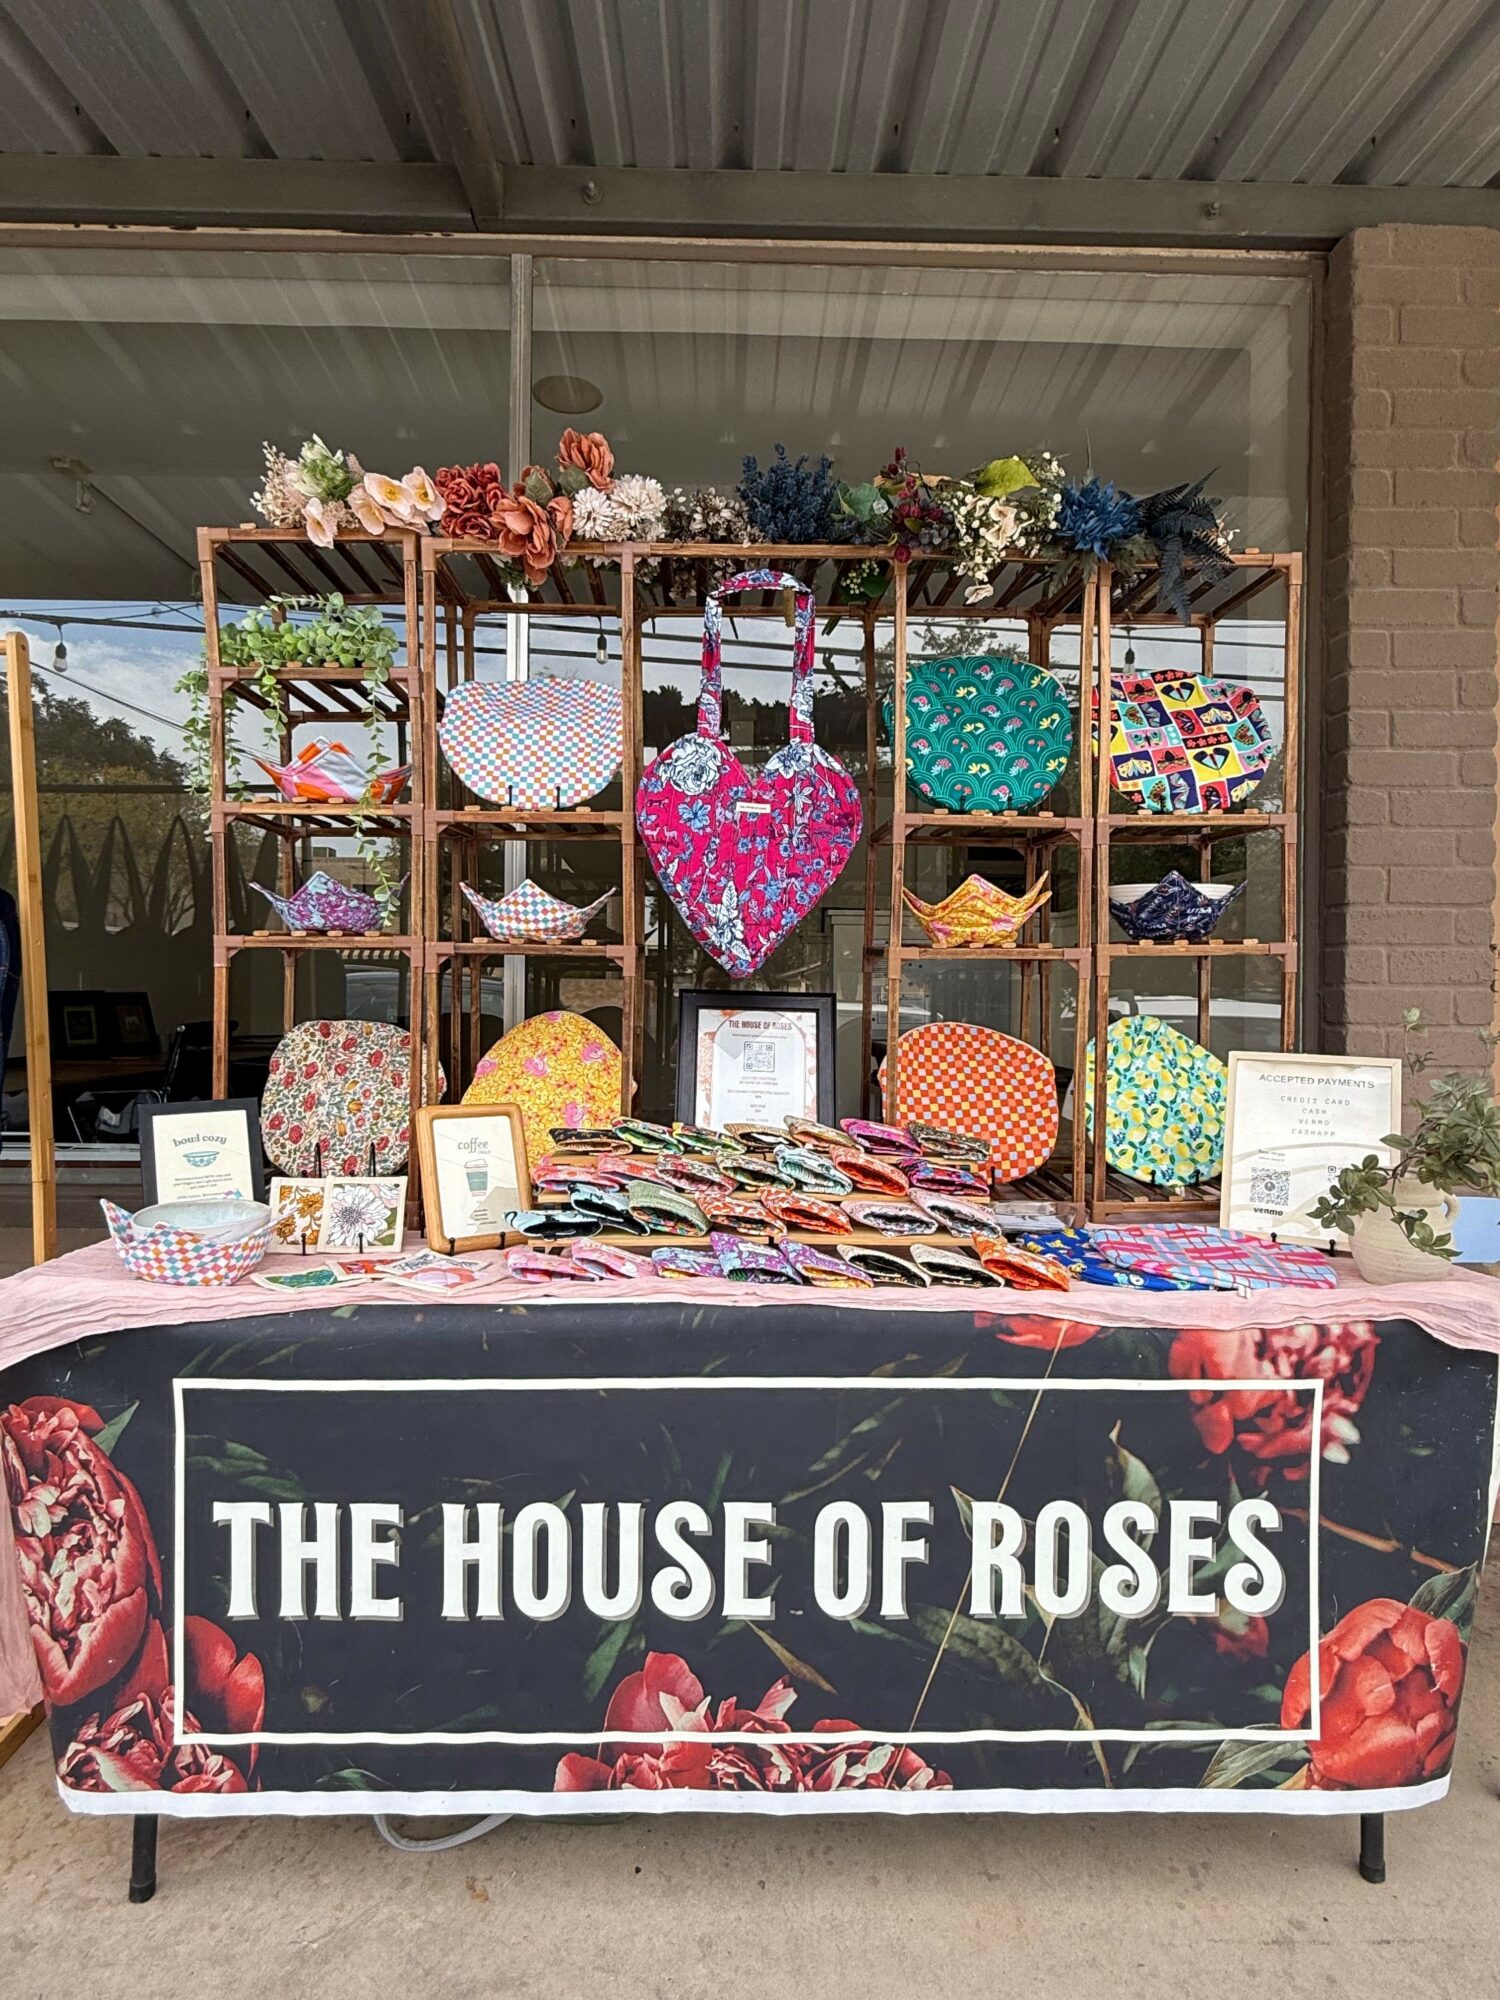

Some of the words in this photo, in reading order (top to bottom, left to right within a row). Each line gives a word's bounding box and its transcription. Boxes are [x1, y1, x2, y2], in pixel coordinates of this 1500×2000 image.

[729, 1020, 740, 1028] THE
[741, 1020, 762, 1029] HOUSE
[763, 1021, 771, 1030] OF
[1259, 1074, 1315, 1085] ACCEPTED
[1317, 1078, 1375, 1089] PAYMENTS
[1280, 1095, 1318, 1105] CREDIT
[1324, 1098, 1351, 1106] CARD
[1298, 1118, 1330, 1126] VENMO
[1291, 1128, 1336, 1137] CASHAPP
[173, 1133, 200, 1147] bowl
[202, 1135, 227, 1145] cozy
[457, 1137, 489, 1154] coffee
[1253, 1207, 1284, 1217] venmo
[212, 1499, 404, 1621] THE
[440, 1499, 777, 1622] HOUSE
[813, 1500, 934, 1621] OF
[969, 1498, 1286, 1620] ROSES
